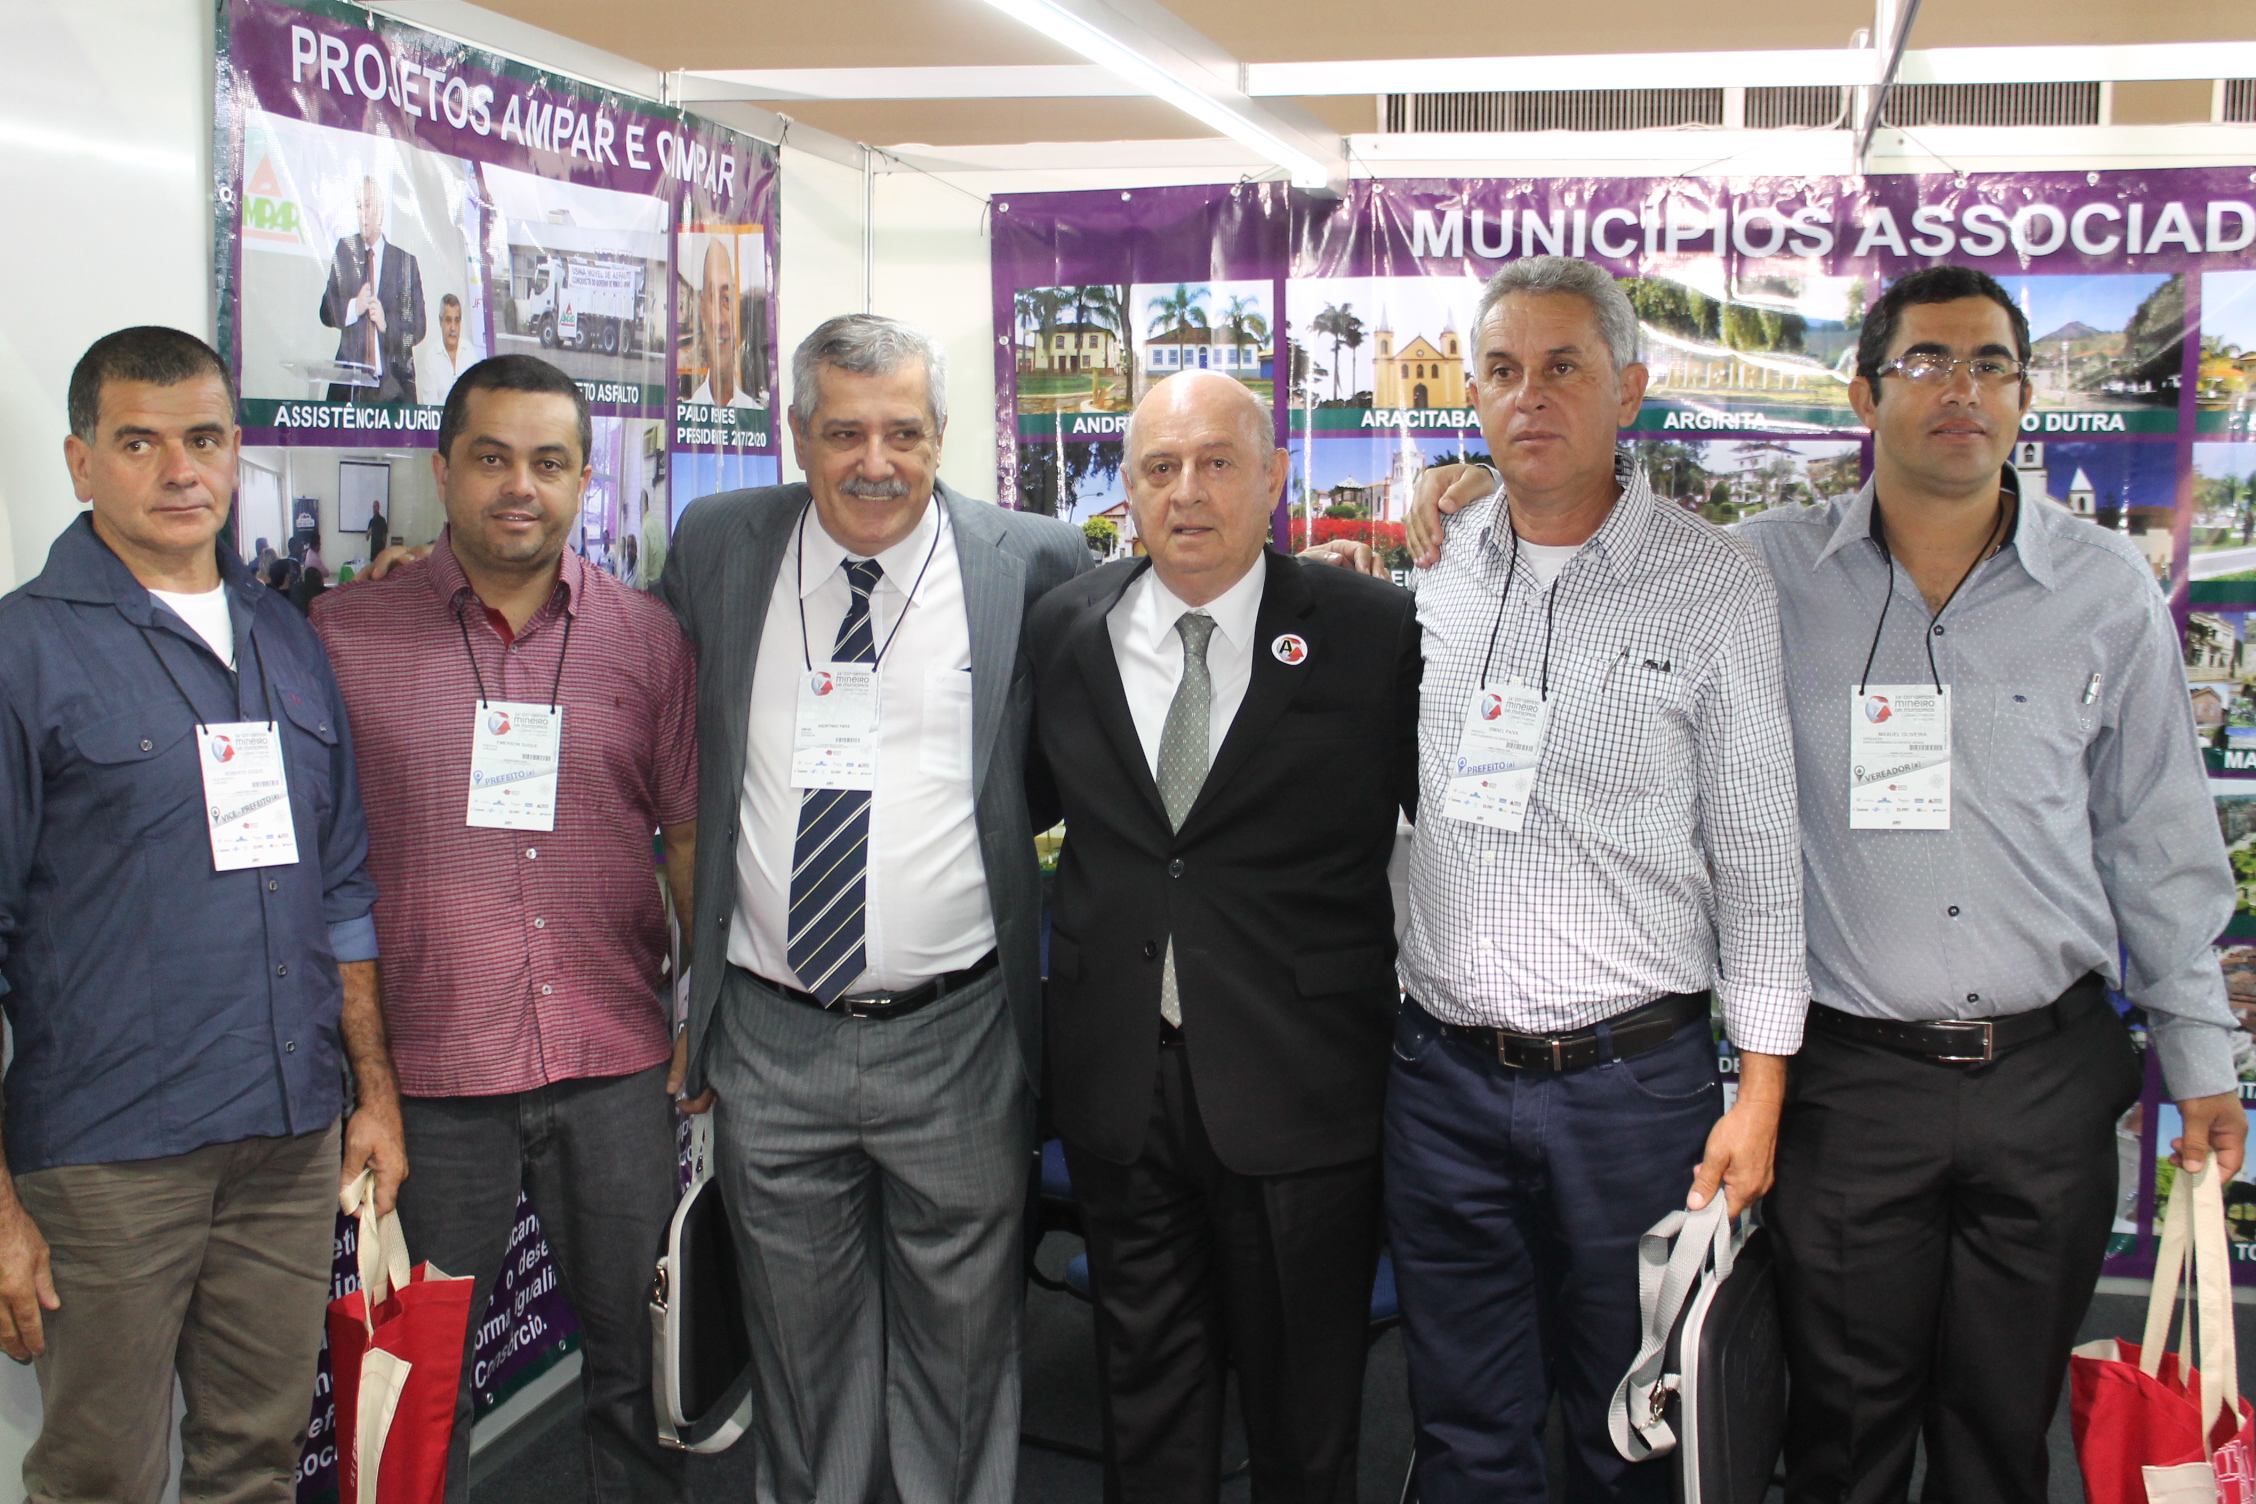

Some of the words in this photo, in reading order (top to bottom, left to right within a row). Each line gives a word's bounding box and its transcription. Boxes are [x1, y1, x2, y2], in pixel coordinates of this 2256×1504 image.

[291, 25, 494, 137] PROJETOS
[501, 93, 619, 167] AMPAR
[626, 124, 651, 170] E
[1413, 202, 1834, 259] MUNICÍPIOS
[1853, 200, 2256, 258] ASSOCIAD
[597, 384, 639, 404] ASFALTO
[274, 402, 387, 429] ASSISTÊNCIA
[1663, 411, 1769, 430] ARGIRITA
[2045, 413, 2126, 432] DUTRA
[1467, 762, 1505, 774] PREFEITO
[1865, 763, 1911, 782] VEREADOR
[485, 771, 525, 785] PREFEITO
[221, 811, 237, 822] VICE
[241, 796, 271, 813] PREFEITO
